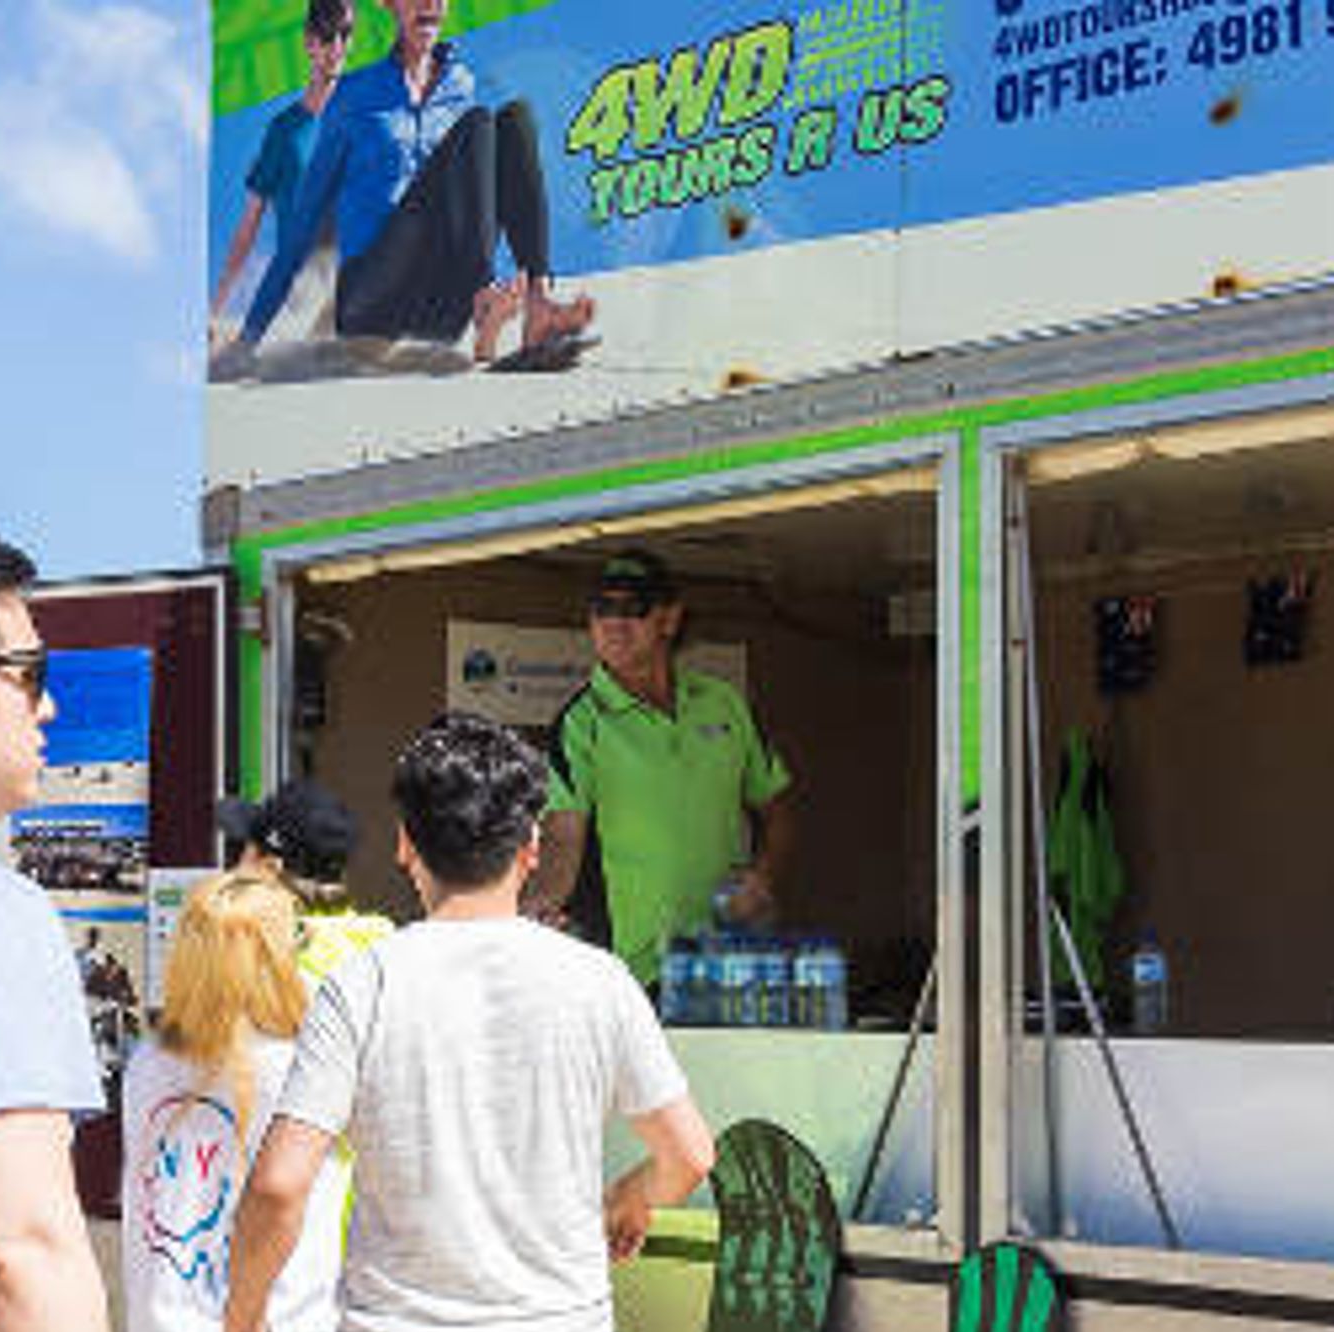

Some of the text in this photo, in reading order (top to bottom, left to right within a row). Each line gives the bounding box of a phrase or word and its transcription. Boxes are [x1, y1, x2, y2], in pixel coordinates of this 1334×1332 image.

[565, 20, 793, 162] 4WD
[994, 38, 1167, 123] OFFICE:
[1186, 0, 1301, 68] 4981
[589, 74, 952, 222] TOURS R US
